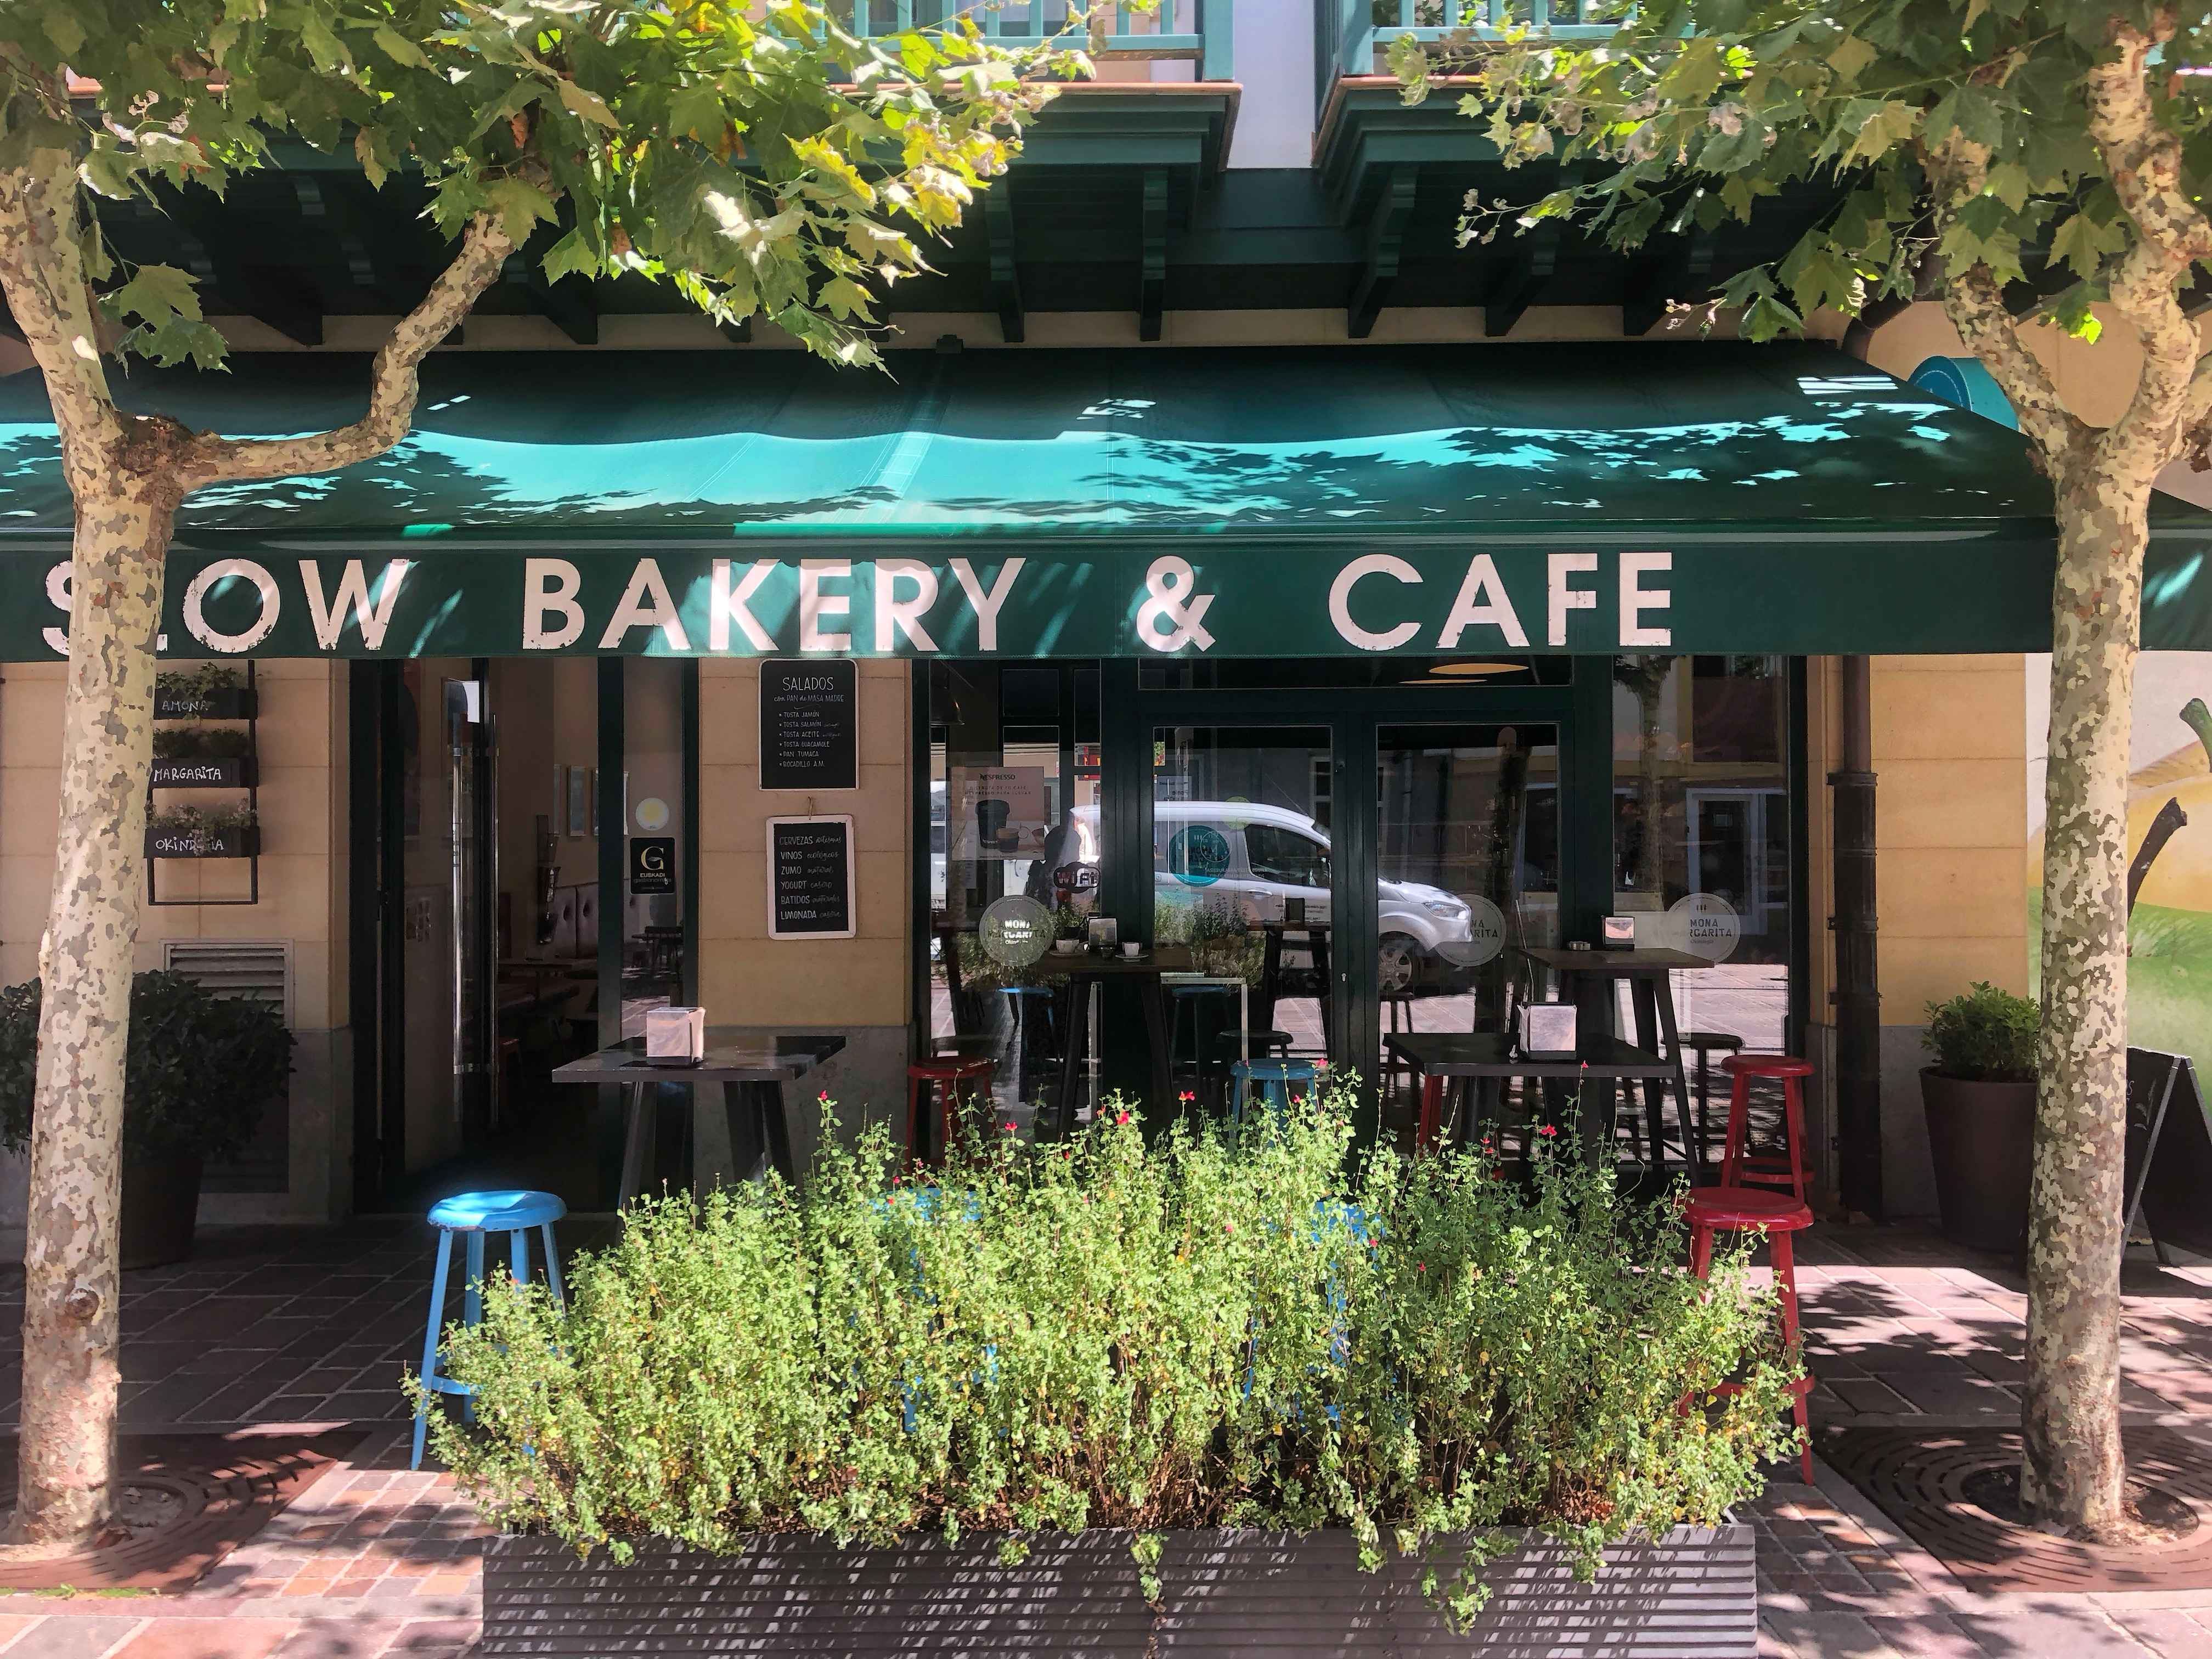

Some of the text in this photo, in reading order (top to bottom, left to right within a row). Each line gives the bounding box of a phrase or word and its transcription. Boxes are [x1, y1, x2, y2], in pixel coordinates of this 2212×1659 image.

[42, 552, 1673, 653] SOW BAKERY & CAFE
[782, 676, 834, 691] SALADOS
[779, 836, 813, 845] CERVEZAS
[781, 851, 803, 860] VINOS
[781, 866, 802, 875] ZUMO
[781, 880, 808, 890] YOGURT
[781, 895, 810, 905] BATIDOS
[781, 910, 817, 920] LIMONADA
[1690, 918, 1718, 927] MONA
[1690, 928, 1733, 938] RGARITA
